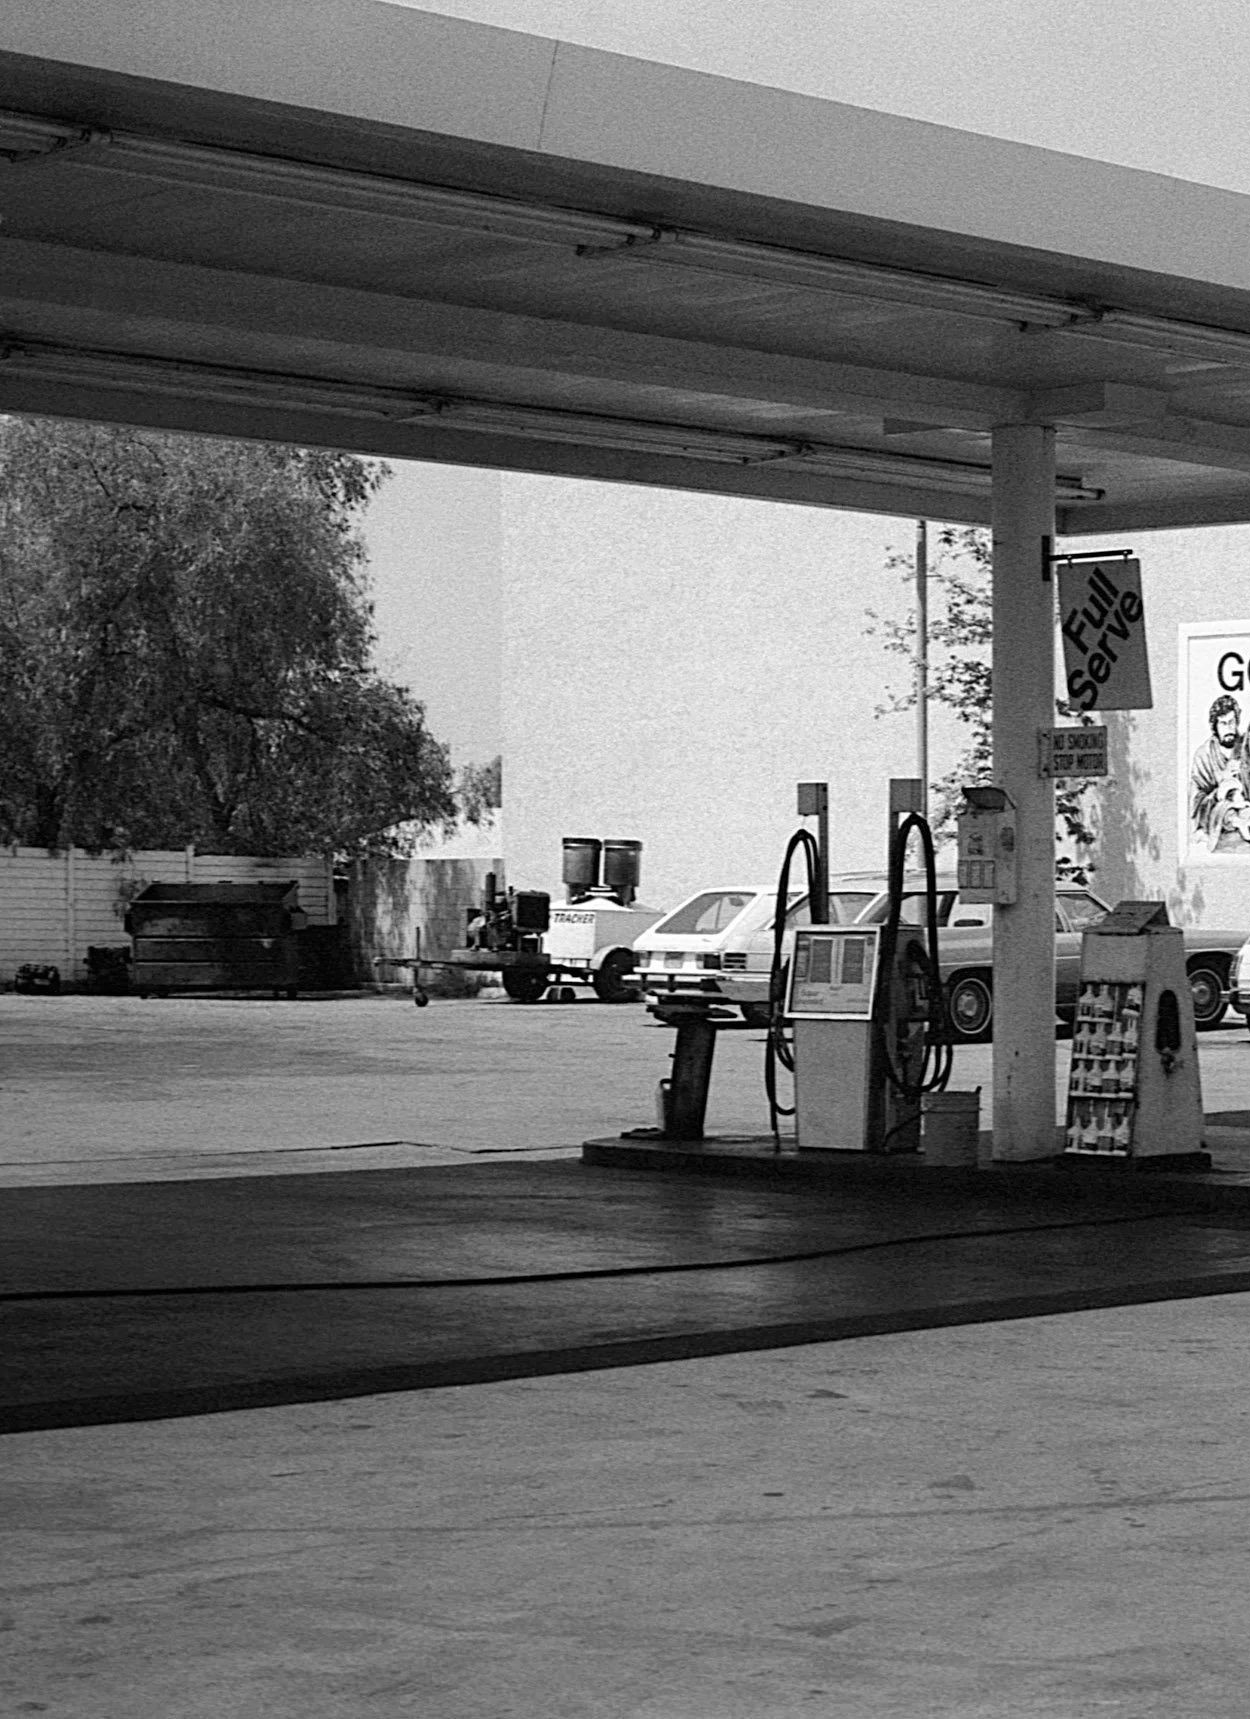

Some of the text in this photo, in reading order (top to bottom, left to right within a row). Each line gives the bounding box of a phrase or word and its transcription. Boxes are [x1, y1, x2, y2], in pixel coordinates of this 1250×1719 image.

[1062, 567, 1120, 655] Full
[1067, 590, 1144, 711] Serve
[1053, 732, 1104, 750] NO SMOKING
[1053, 753, 1104, 771] STOP MOTOR
[554, 913, 595, 924] TRACKER
